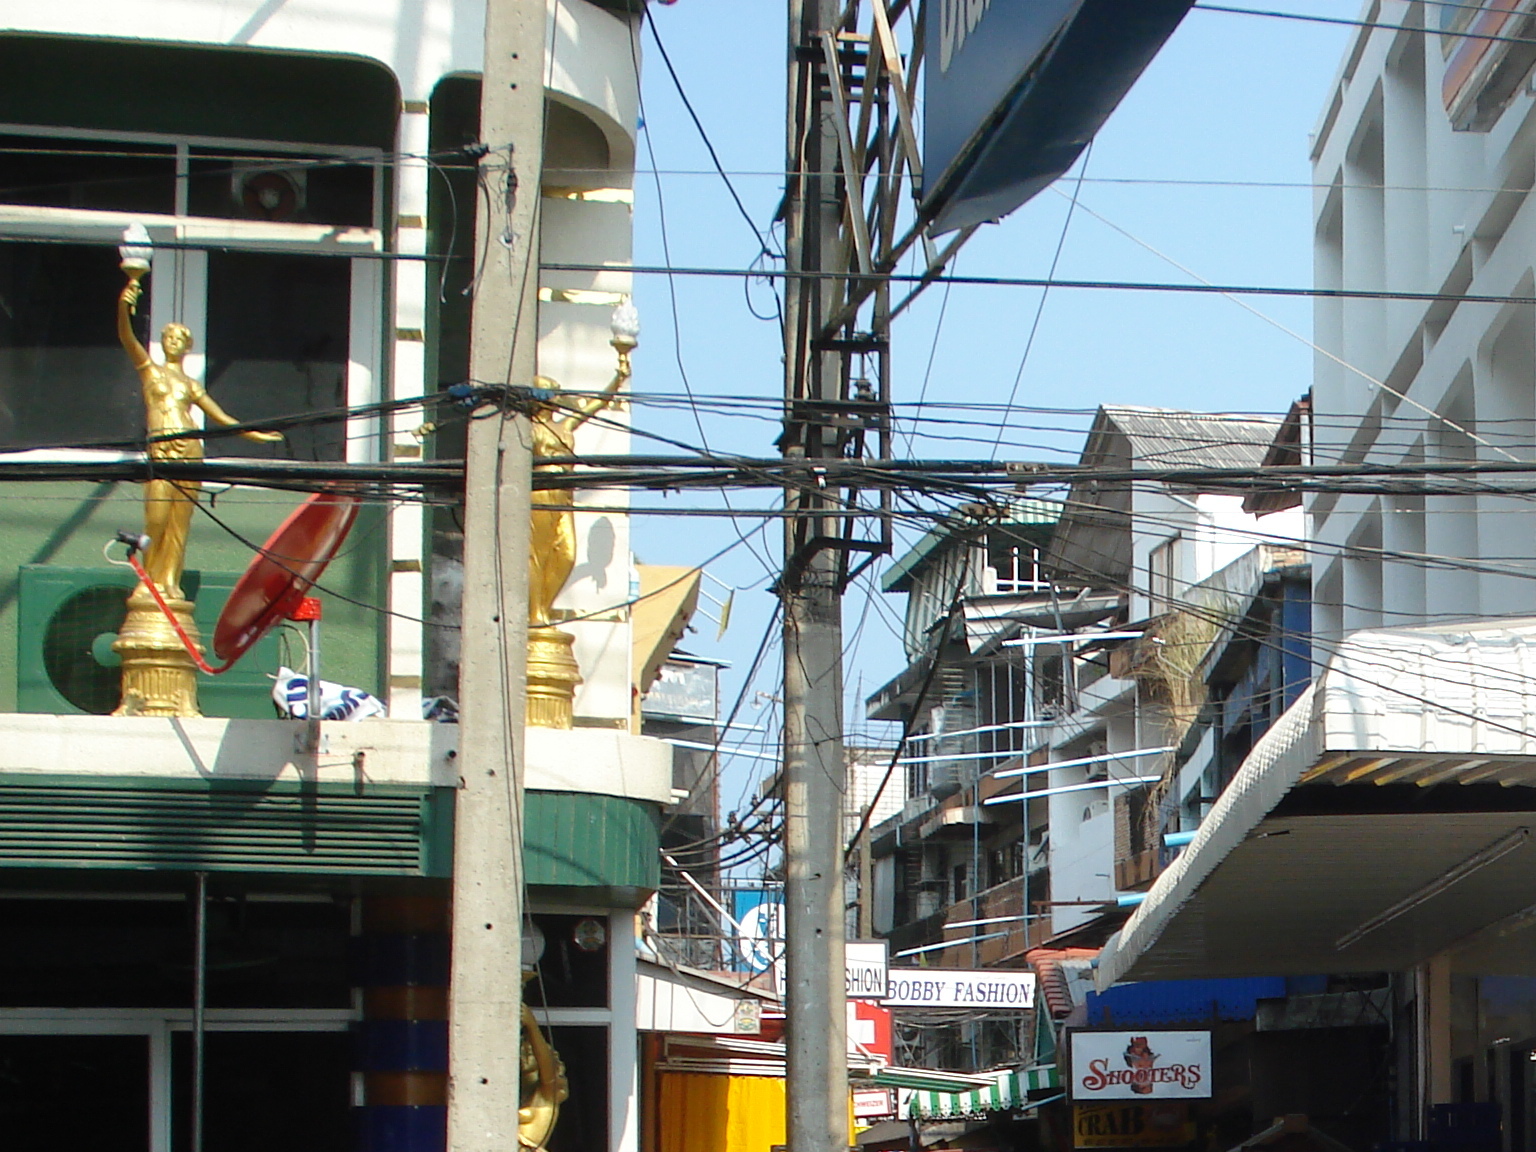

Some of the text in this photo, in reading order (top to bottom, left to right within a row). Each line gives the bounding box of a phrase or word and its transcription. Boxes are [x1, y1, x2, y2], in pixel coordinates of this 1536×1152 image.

[888, 980, 1031, 1004] BOBBY FASHION
[1082, 1057, 1202, 1091] SHOOTERS
